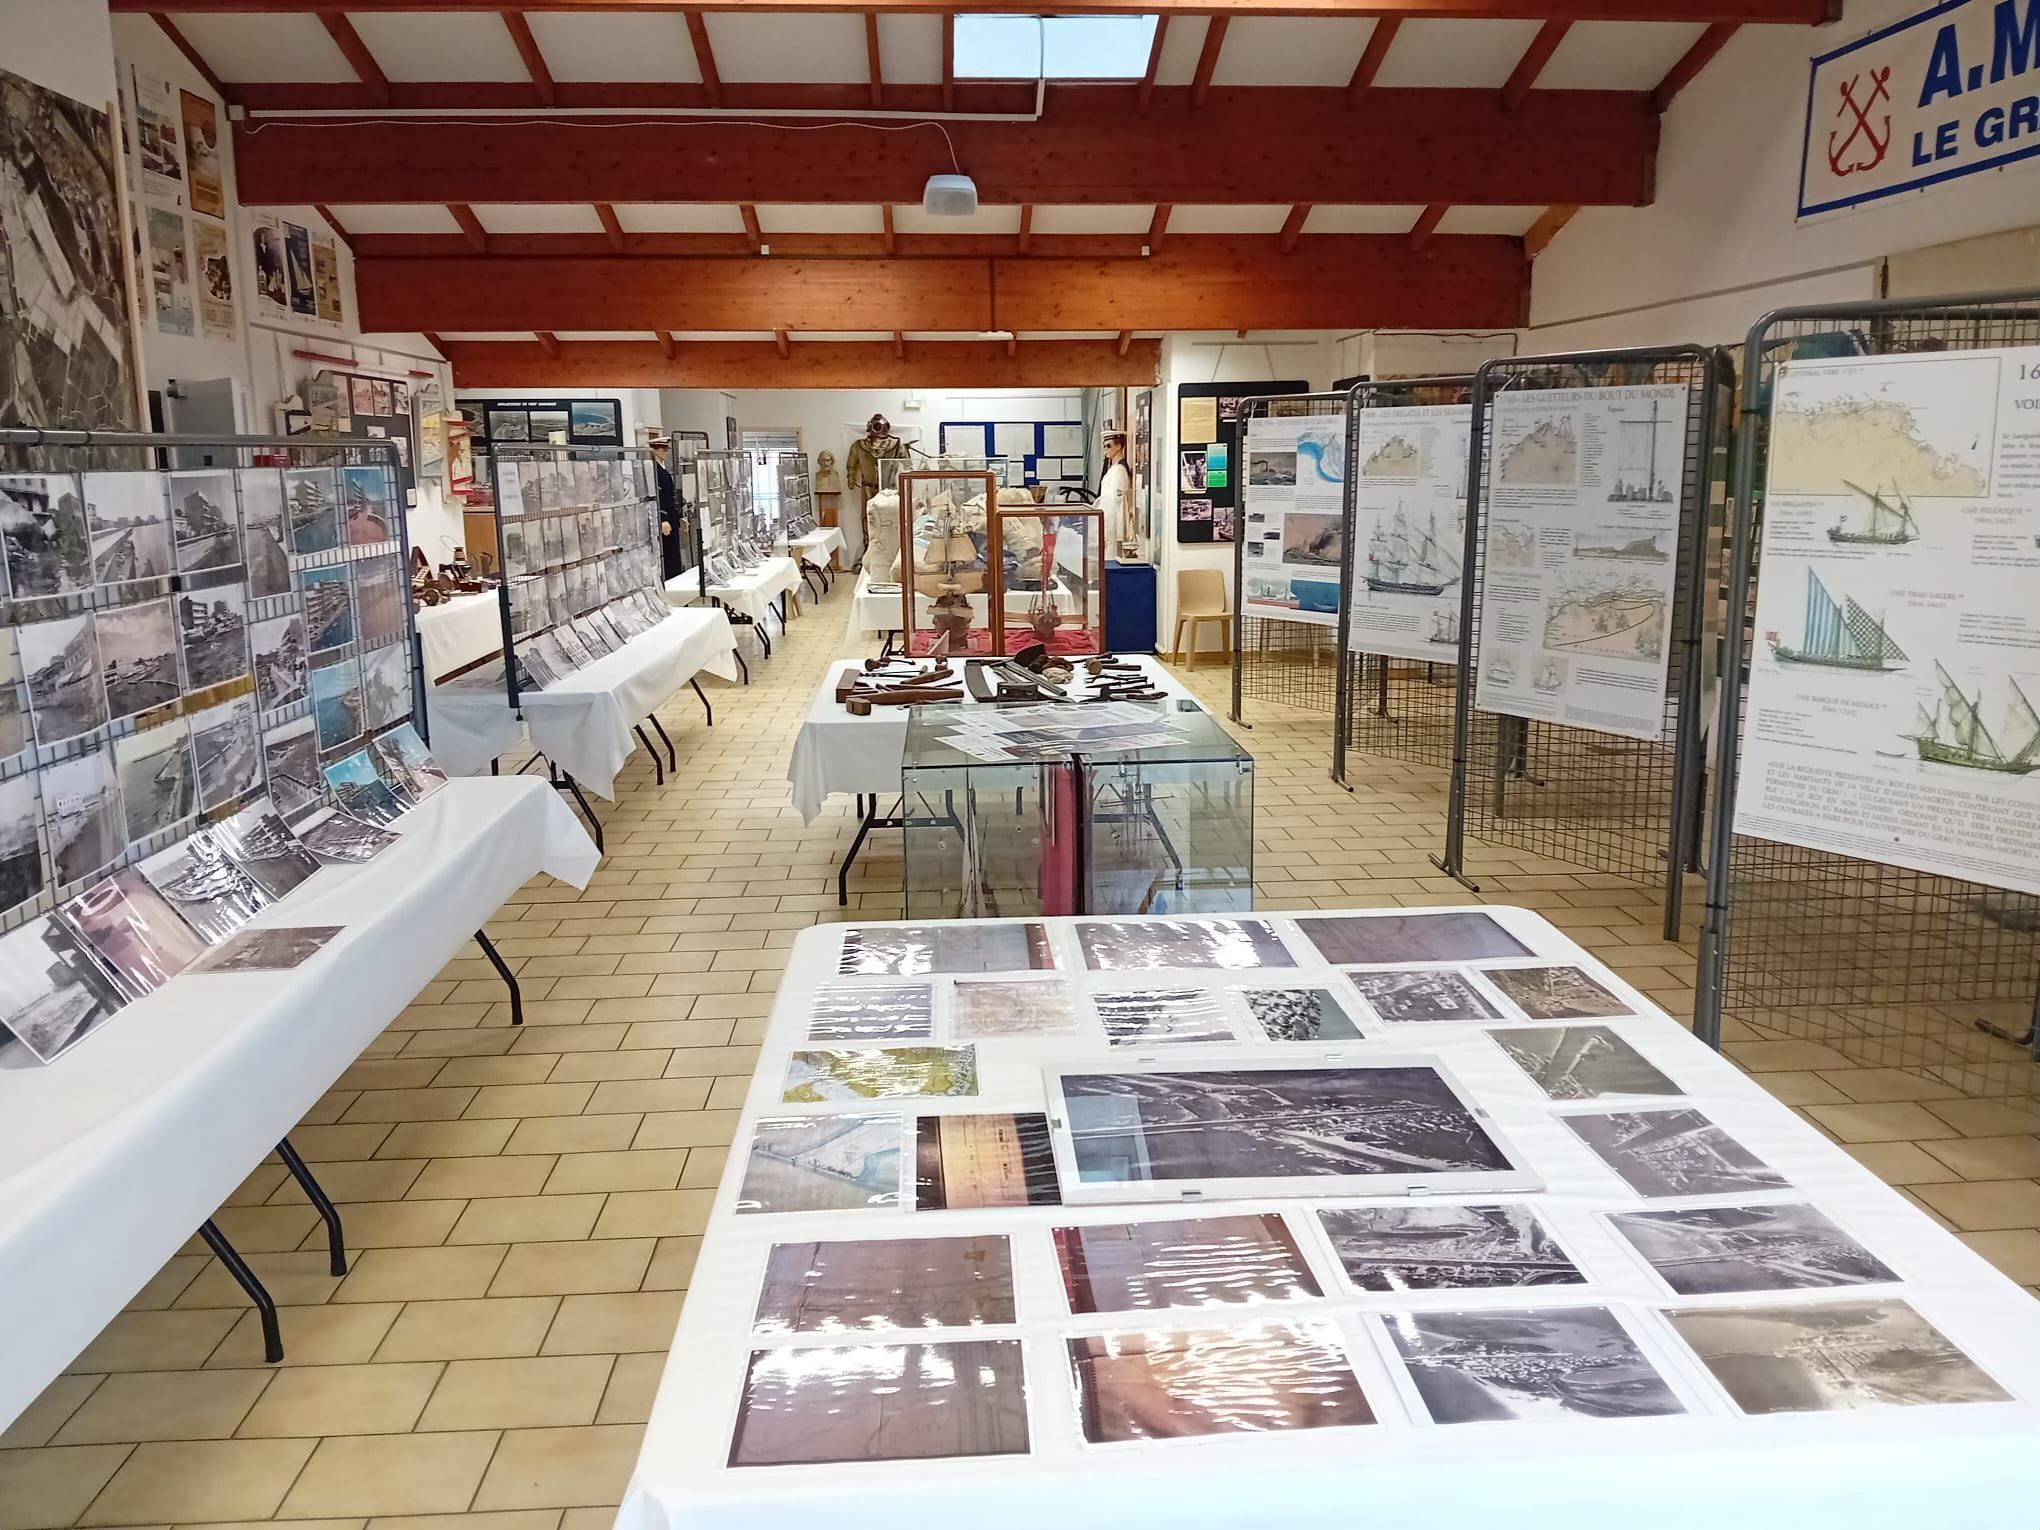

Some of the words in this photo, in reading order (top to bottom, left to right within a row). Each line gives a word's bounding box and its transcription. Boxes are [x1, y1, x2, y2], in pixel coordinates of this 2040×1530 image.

[1918, 0, 2040, 108] A.M
[1912, 120, 1960, 167] LE
[1975, 96, 2040, 148] GR
[1584, 390, 1595, 400] DU
[1599, 388, 1622, 400] BOUT
[1623, 388, 1636, 399] DU
[1639, 385, 1677, 398] MONDE
